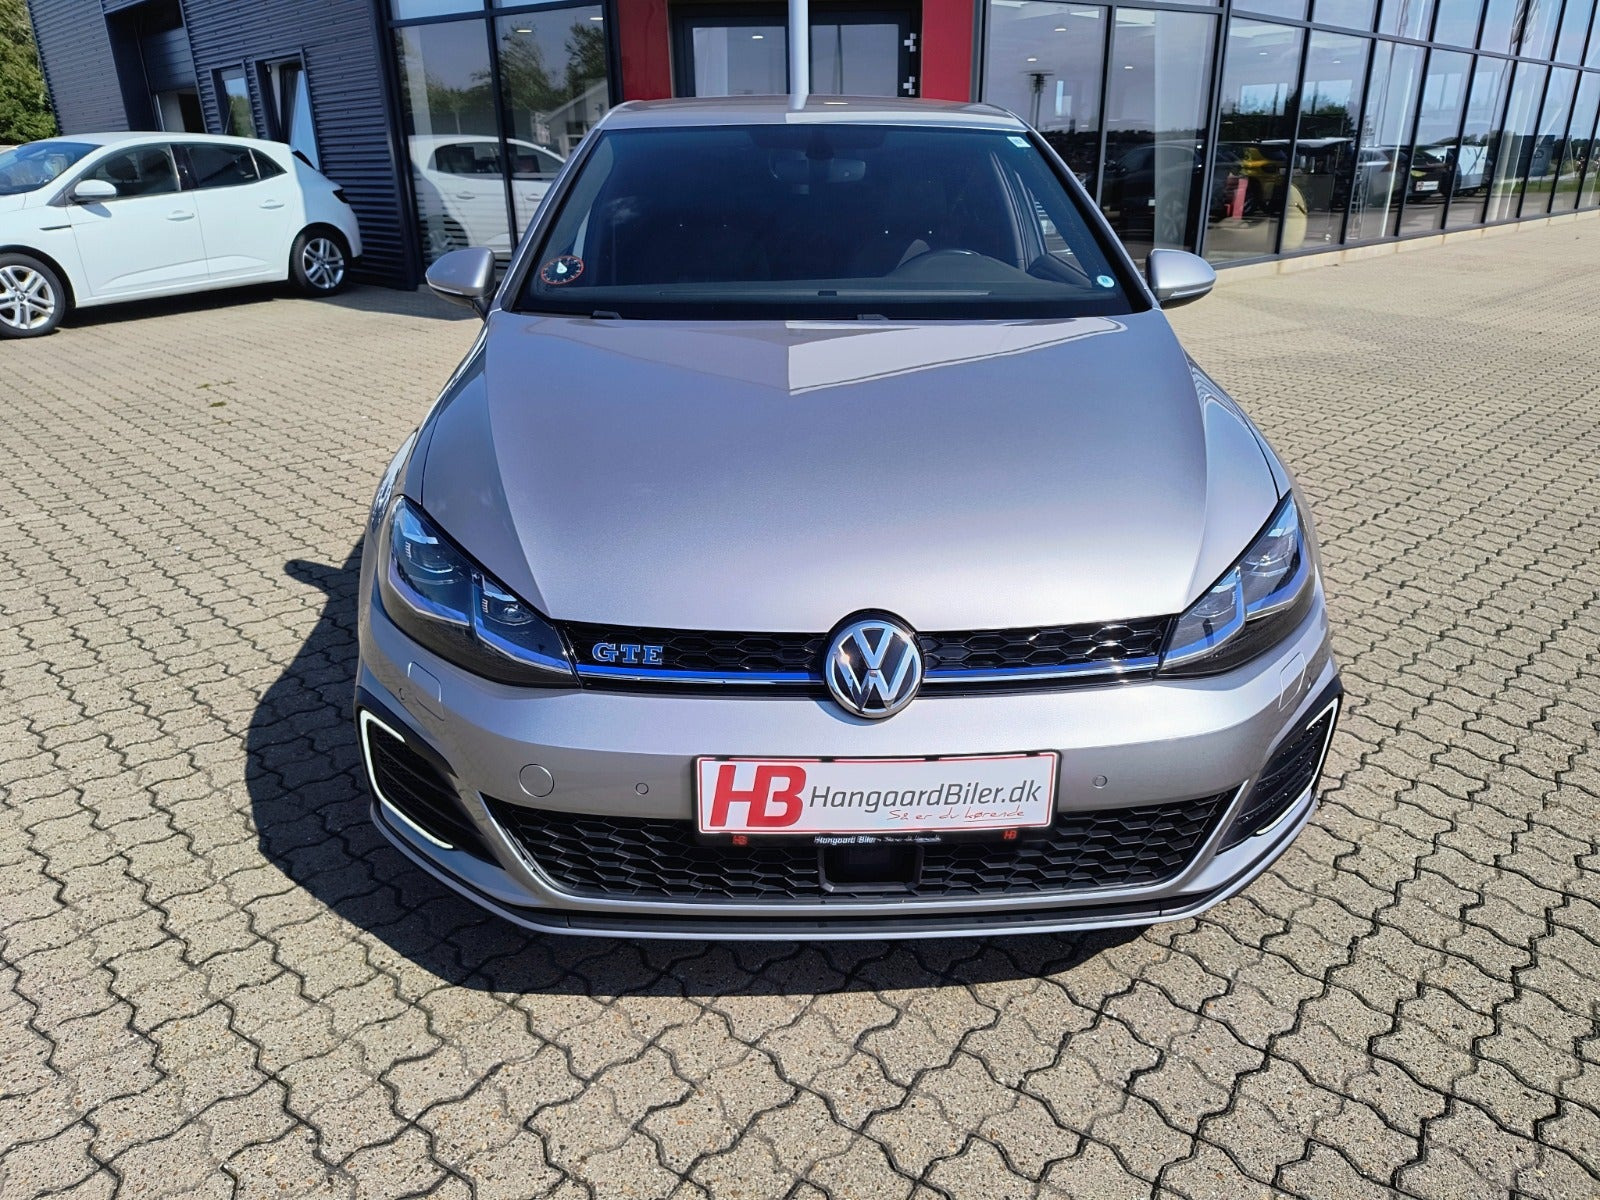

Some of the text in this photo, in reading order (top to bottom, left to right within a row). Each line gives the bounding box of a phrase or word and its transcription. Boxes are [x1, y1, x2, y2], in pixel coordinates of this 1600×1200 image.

[592, 642, 663, 665] GTE
[709, 764, 1042, 827] HB HangaardBiler.dk
[939, 807, 960, 819] du
